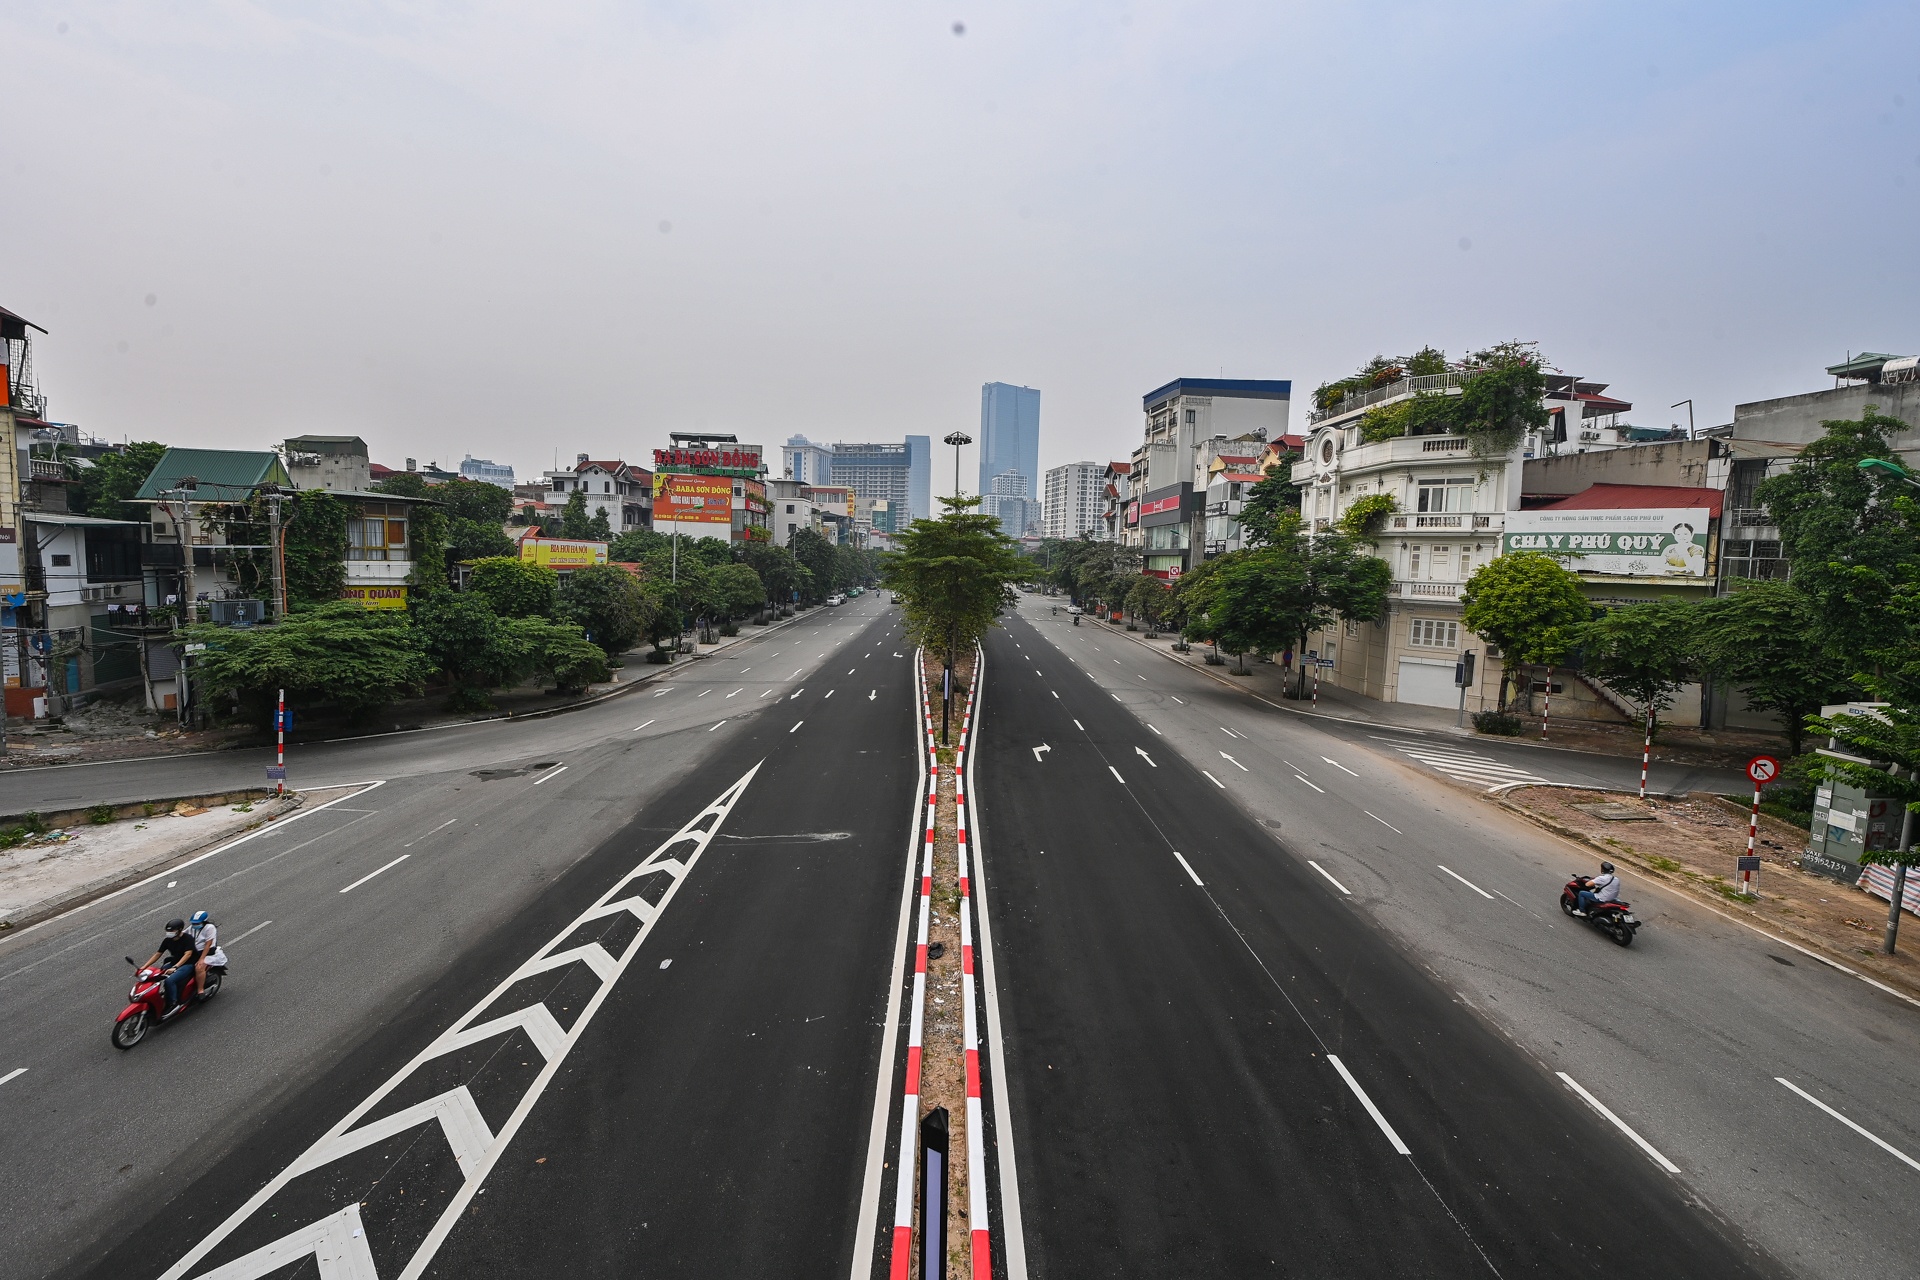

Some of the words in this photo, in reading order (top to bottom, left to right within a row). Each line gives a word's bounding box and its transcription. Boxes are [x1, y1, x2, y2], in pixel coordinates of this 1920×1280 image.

[694, 448, 719, 466] SƠN
[722, 448, 759, 468] ĐÔNG
[675, 485, 695, 493] BABA
[696, 486, 710, 494] SƠN
[712, 486, 731, 495] ĐÔNG
[1509, 534, 1565, 549] CHAY
[1568, 533, 1612, 549] PHÚ
[1617, 533, 1666, 551] QUÝ
